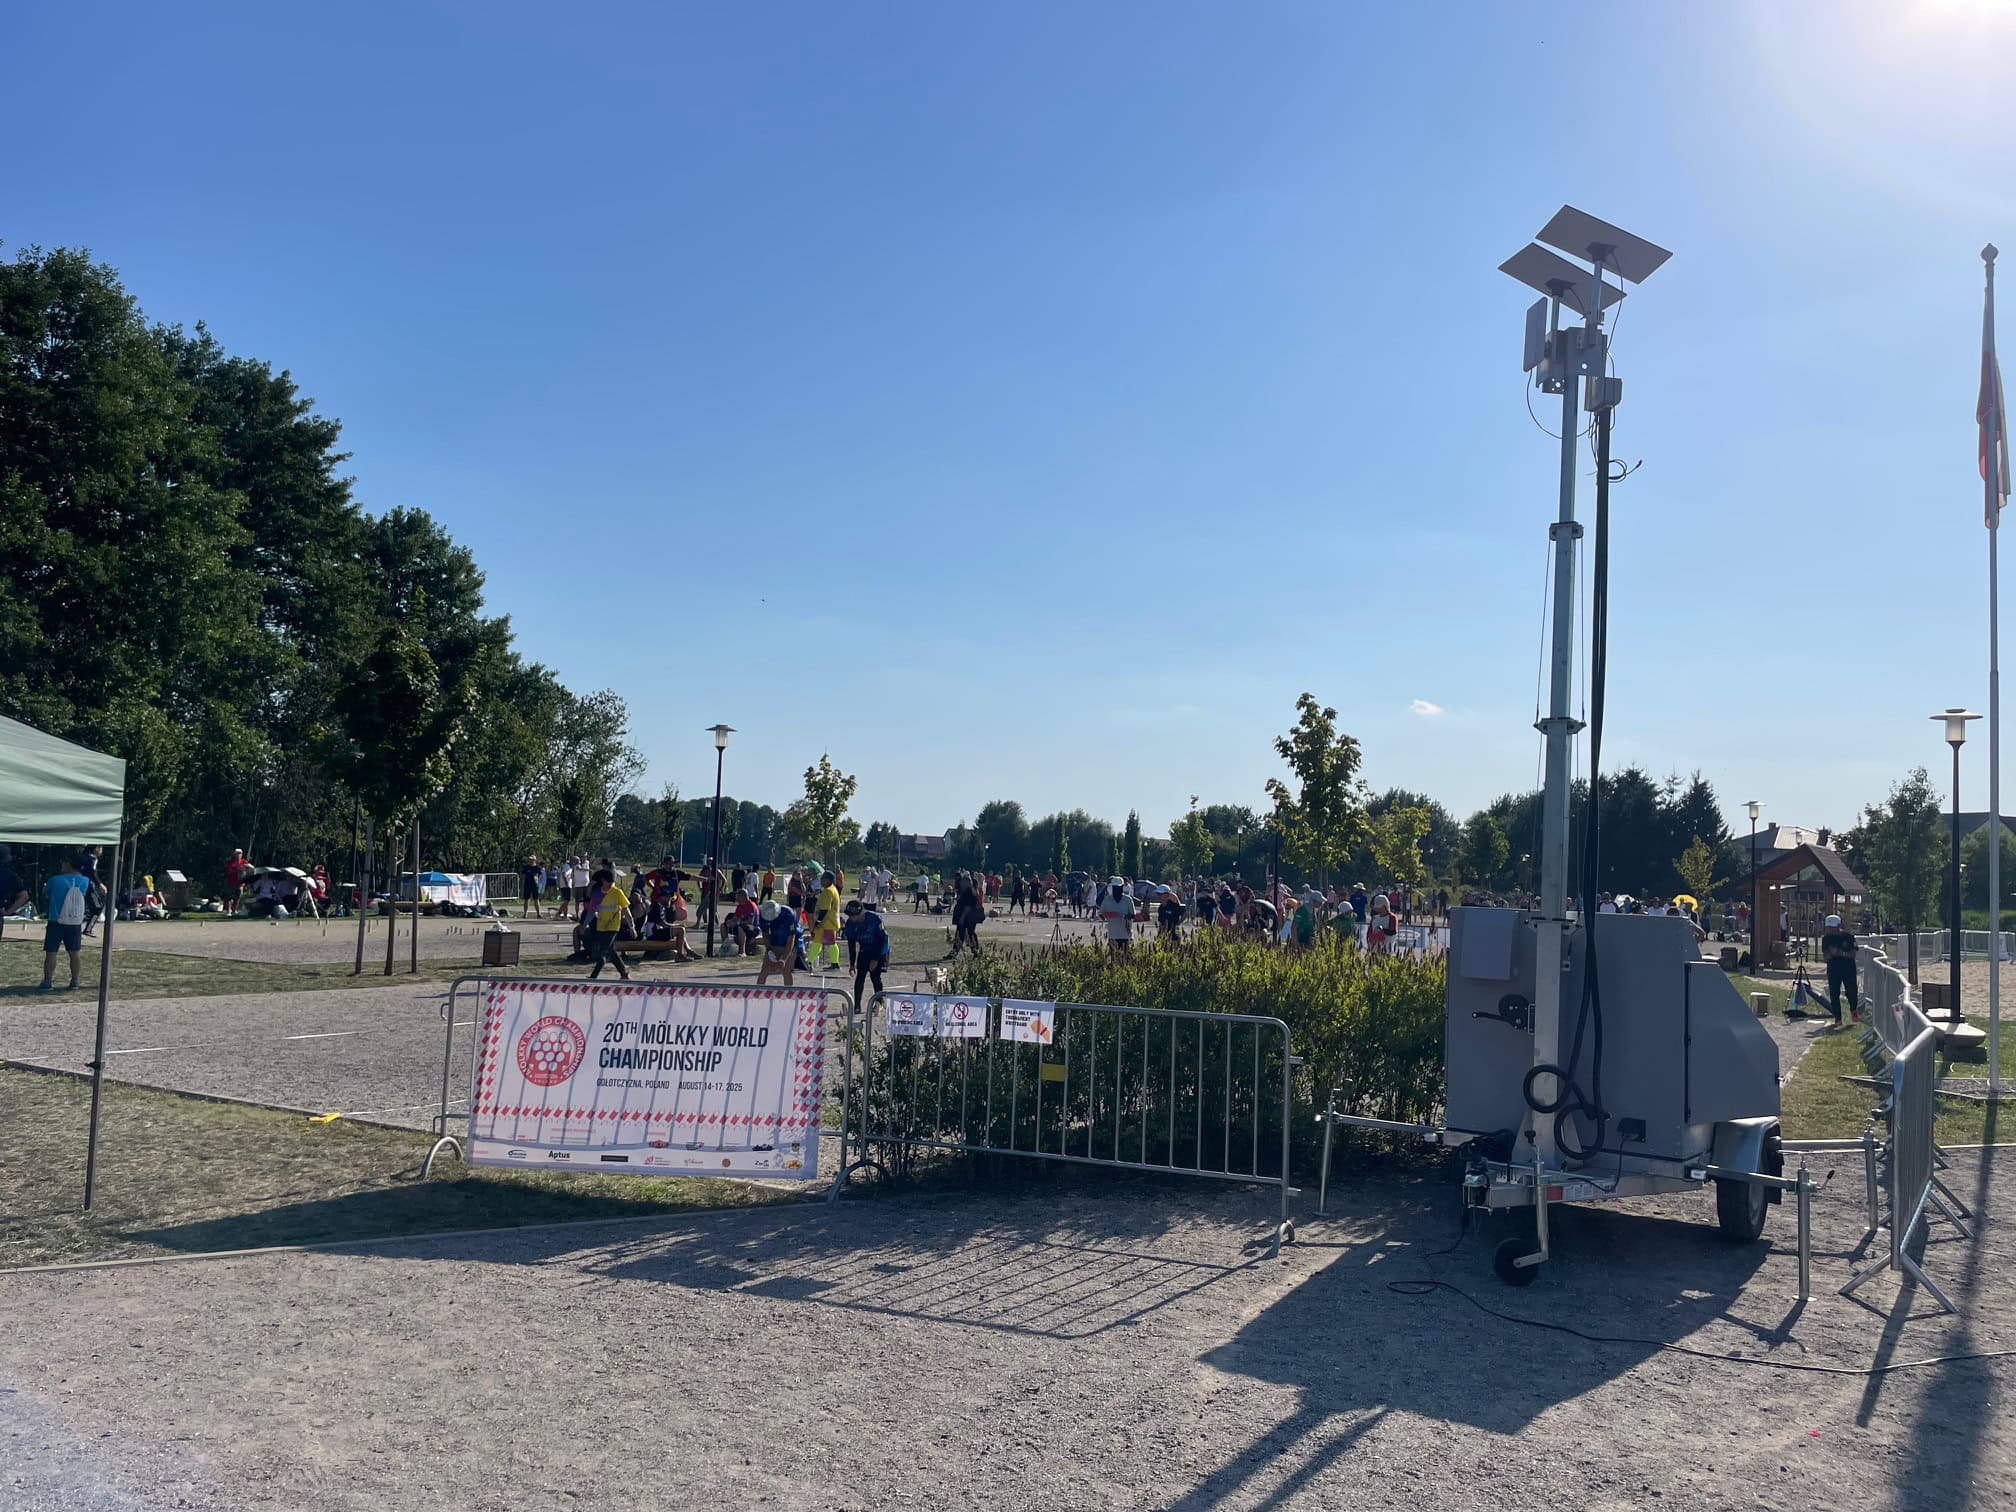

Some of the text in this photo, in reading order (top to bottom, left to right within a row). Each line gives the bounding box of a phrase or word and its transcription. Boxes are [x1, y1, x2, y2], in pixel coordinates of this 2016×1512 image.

[524, 1017, 553, 1039] WORLD
[554, 1017, 585, 1077] CHAMPIONSHIPS
[602, 1020, 769, 1048] 20TH MÖLKKY WORLD
[598, 1047, 722, 1073] CHAMPIONSHIP
[645, 1080, 670, 1090] POLAND
[678, 1081, 702, 1091] AUGUST
[726, 1082, 743, 1092] 2025
[548, 1150, 571, 1159] Aptus
